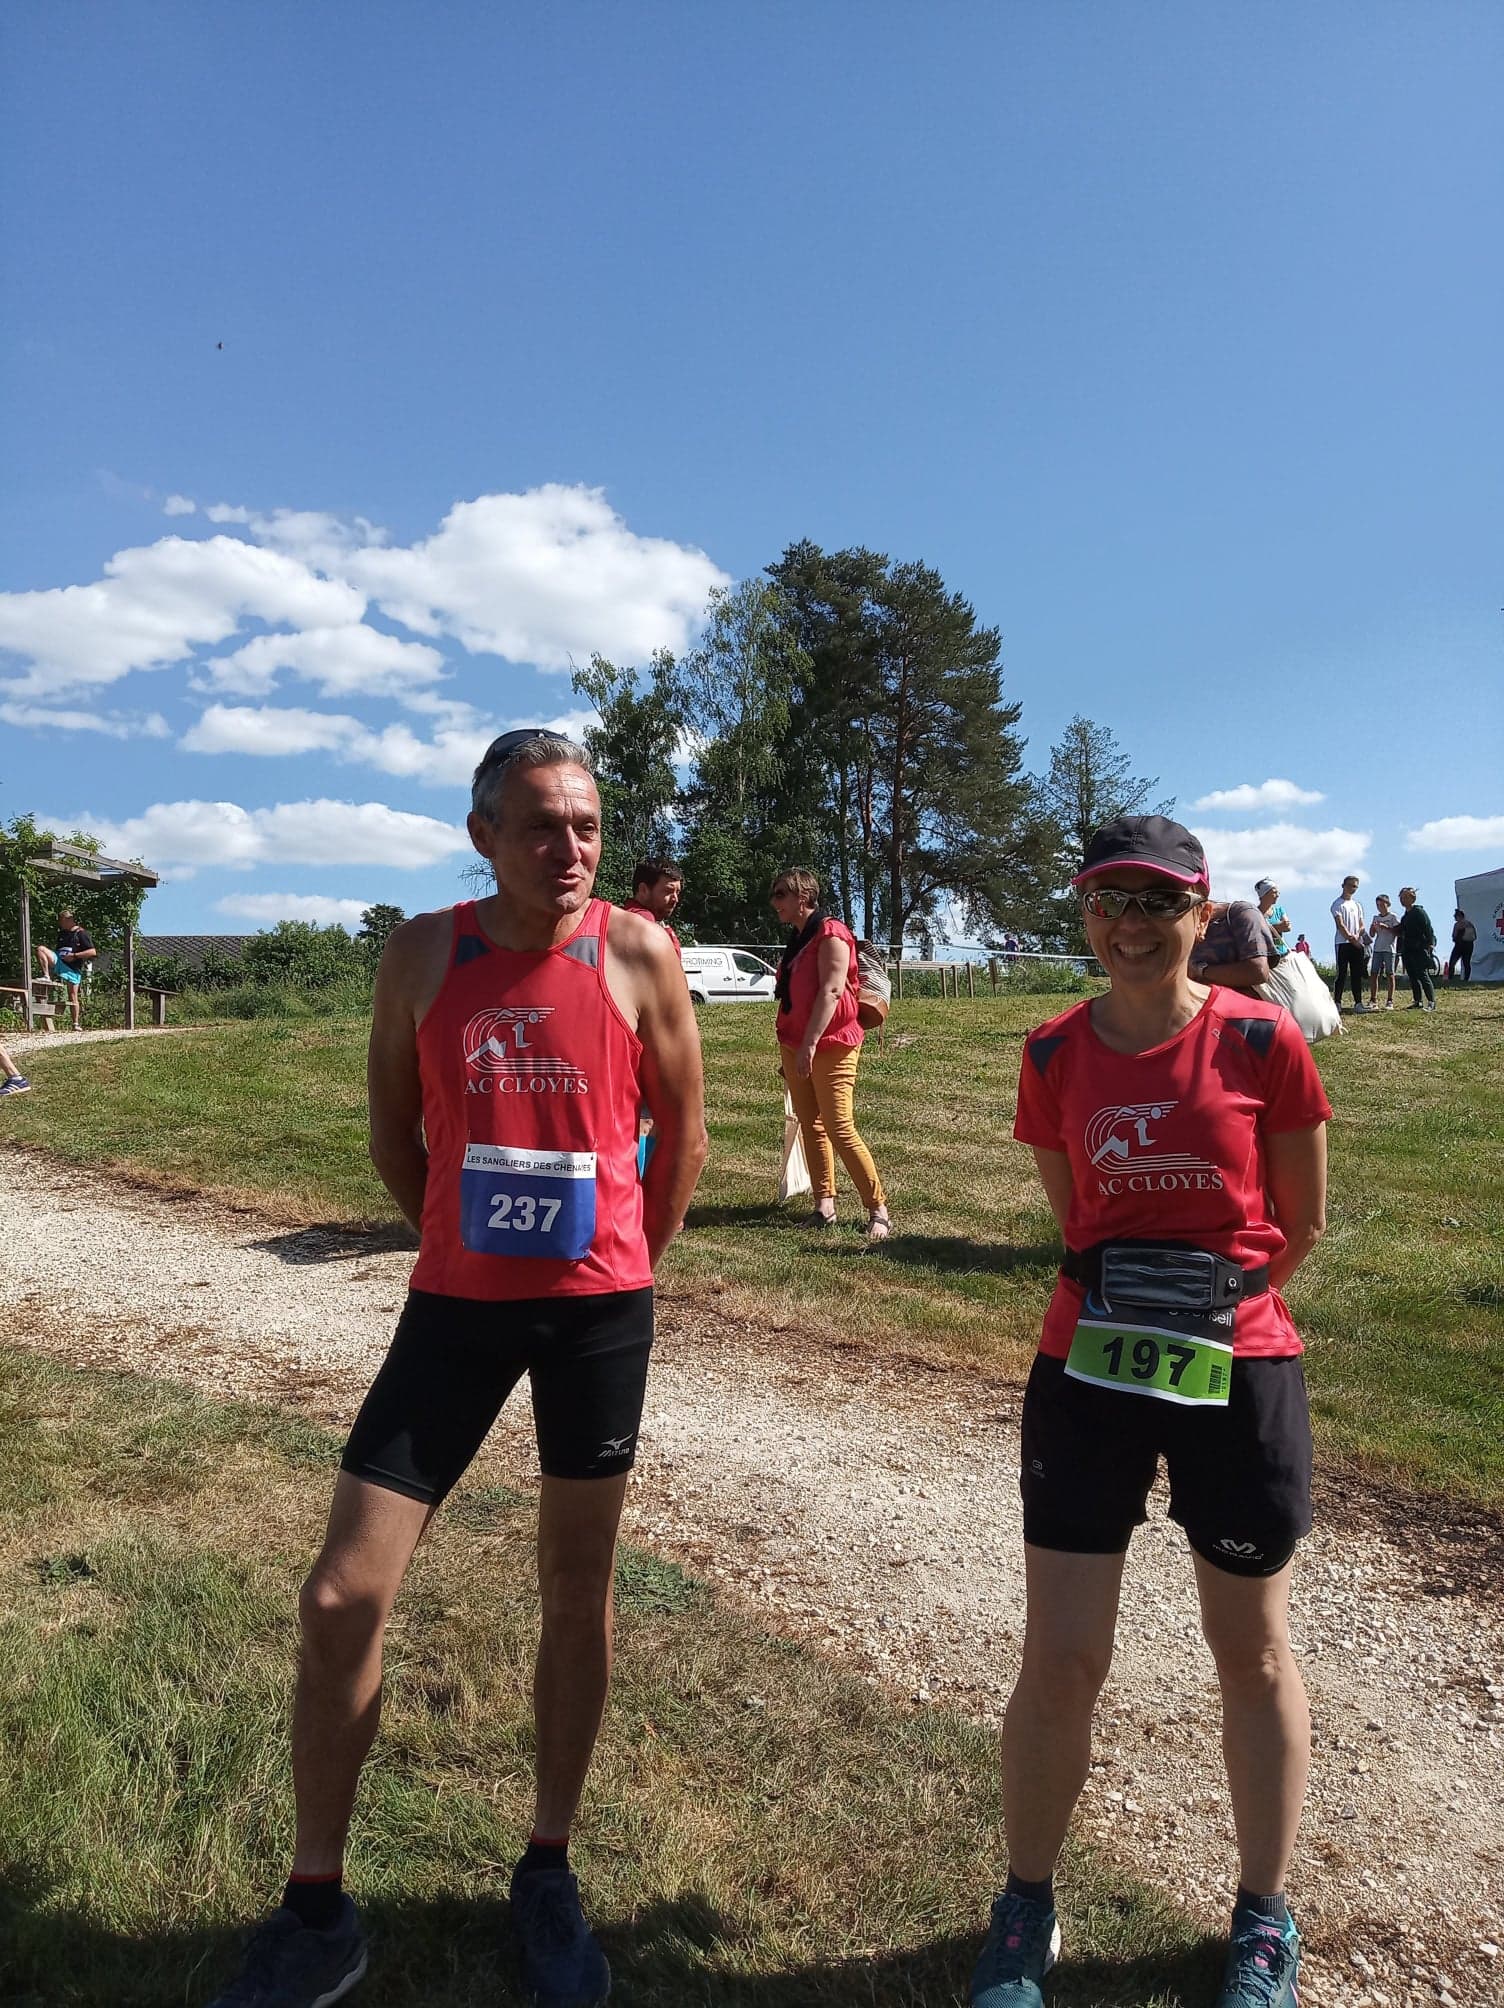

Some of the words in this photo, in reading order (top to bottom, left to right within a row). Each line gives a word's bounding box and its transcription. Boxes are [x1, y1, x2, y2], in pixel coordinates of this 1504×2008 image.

[464, 1078, 493, 1095] AC
[498, 1077, 589, 1095] CLOYES
[467, 1155, 481, 1164] LES
[482, 1157, 532, 1169] SANGLIERS
[533, 1161, 552, 1170] DES
[1098, 1177, 1123, 1196] AC
[1127, 1172, 1224, 1193] CLOYES
[487, 1193, 562, 1233] 237
[1102, 1336, 1196, 1387] 197
